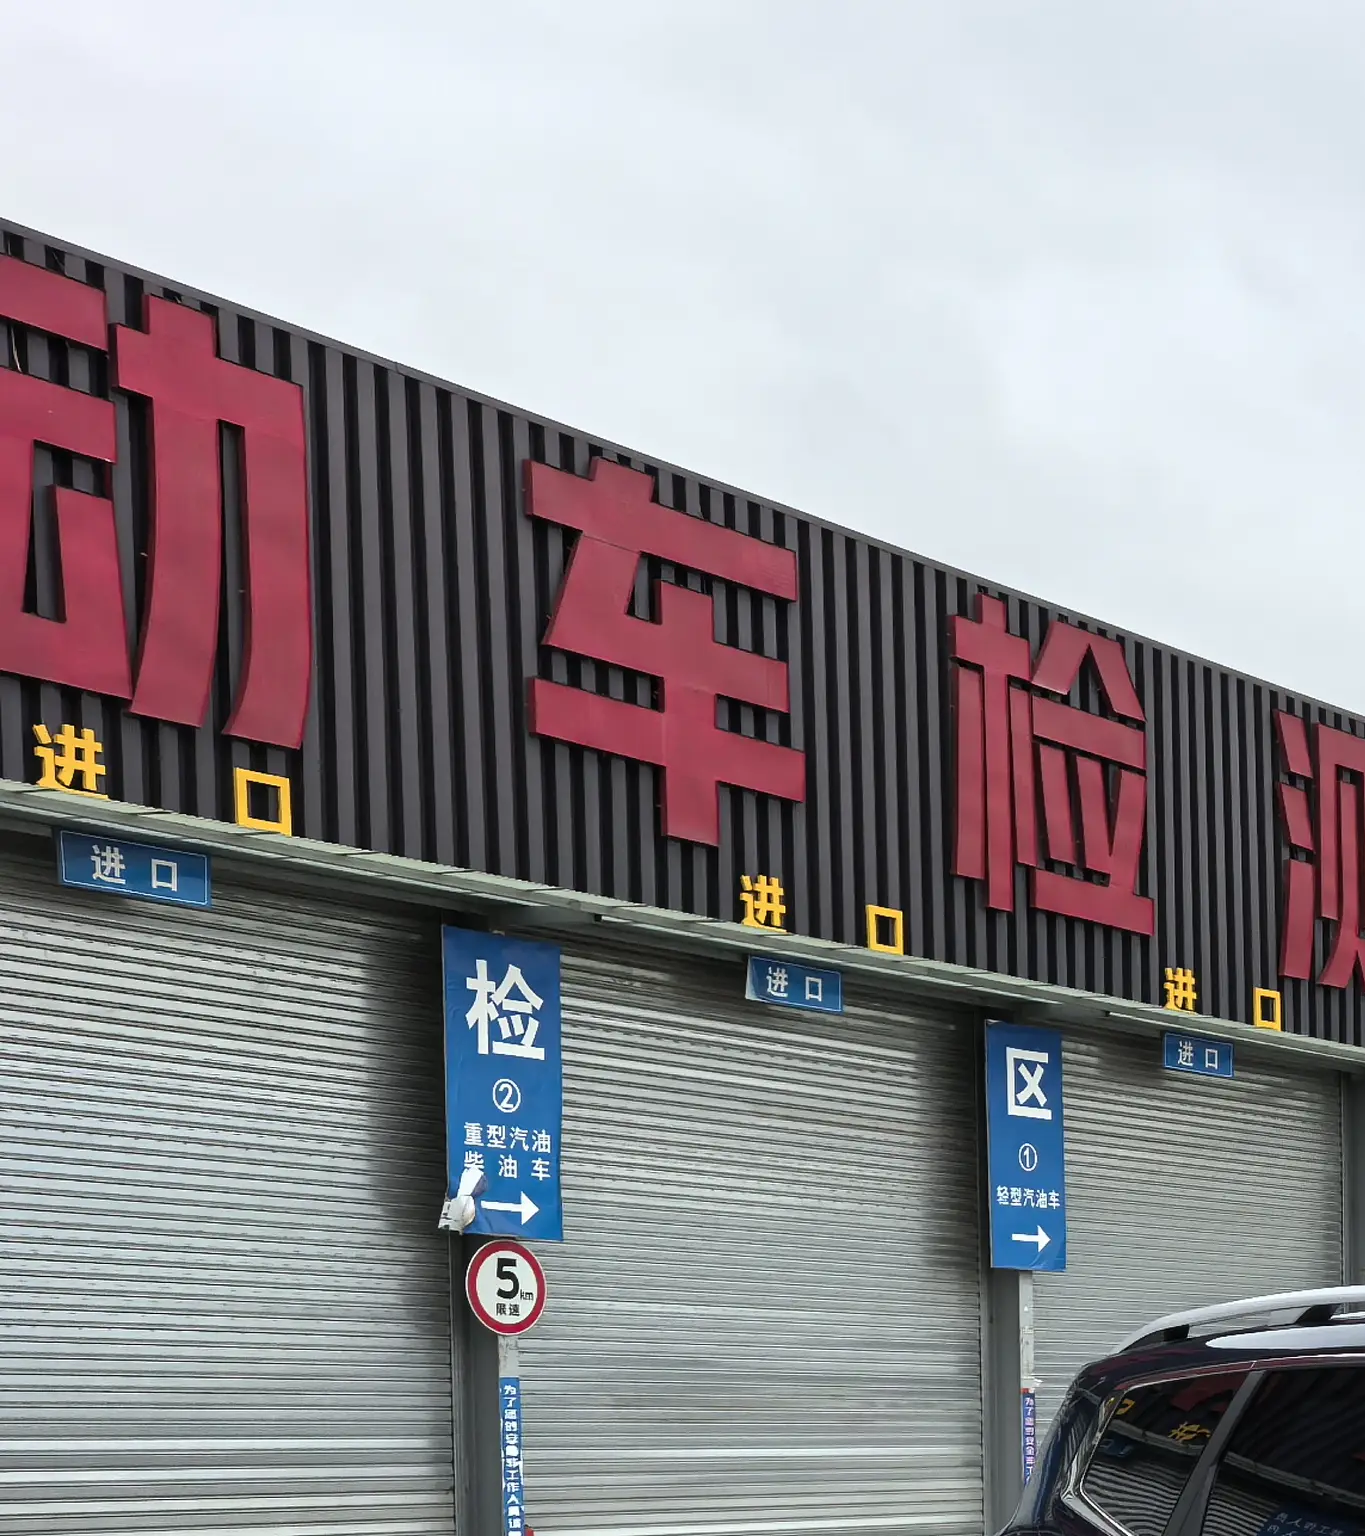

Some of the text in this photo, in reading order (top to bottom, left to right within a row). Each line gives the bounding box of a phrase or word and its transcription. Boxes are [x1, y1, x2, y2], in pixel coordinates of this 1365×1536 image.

[32, 723, 293, 837] 进口
[91, 844, 178, 892] 进口
[740, 874, 904, 956] 进口
[766, 966, 823, 1002] 进口
[1163, 967, 1282, 1032] 进口
[466, 959, 545, 1060] 检
[1177, 1040, 1218, 1070] 进口
[1006, 1046, 1052, 1120] 区
[463, 1121, 552, 1154] 重型汽油
[996, 1185, 1061, 1210] 轻型汽油车
[496, 1257, 520, 1300] 5
[495, 1302, 520, 1316] 限速
